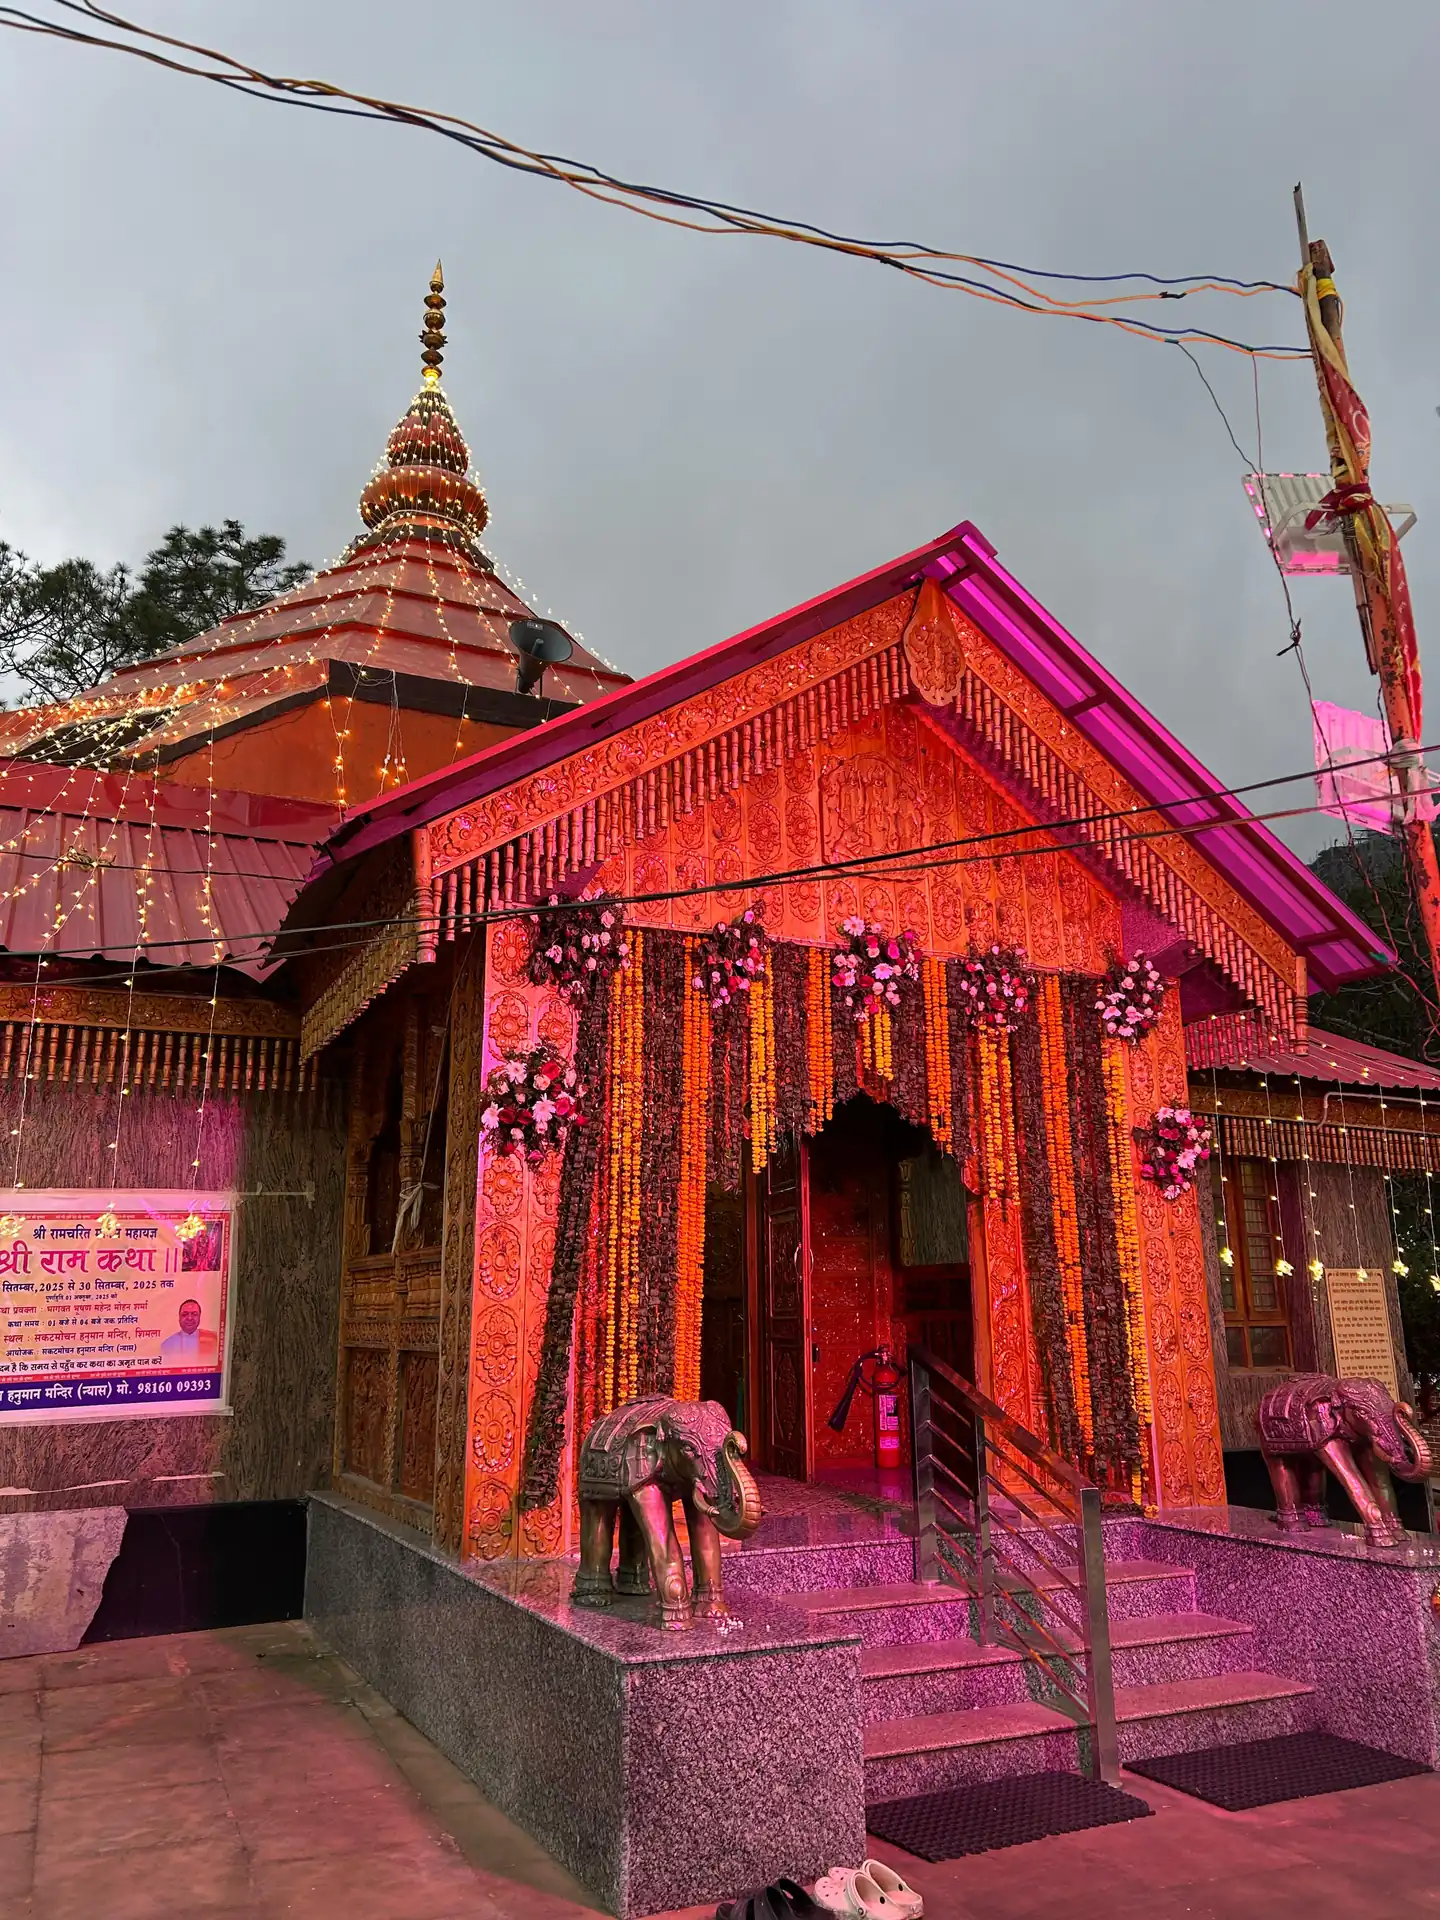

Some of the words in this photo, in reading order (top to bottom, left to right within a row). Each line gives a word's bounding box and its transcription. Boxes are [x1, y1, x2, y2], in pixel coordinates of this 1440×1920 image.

[33, 1225, 46, 1239] श्री
[50, 1224, 91, 1239] रामचरित
[125, 1228, 158, 1240] महायज्ञ
[40, 1250, 90, 1274] राम
[97, 1248, 157, 1272] कथा
[67, 1279, 75, 1291] से
[79, 1282, 91, 1290] 30
[133, 1281, 157, 1289] 2025
[160, 1280, 174, 1288] तक
[114, 1302, 131, 1311] मोहन
[4, 1334, 23, 1343] स्थल
[79, 1332, 104, 1343] हनुमान
[135, 1327, 161, 1338] शिमला
[76, 1346, 96, 1356] हनुमान
[19, 1362, 29, 1371] कि
[31, 1363, 49, 1371] समय
[51, 1360, 58, 1369] से
[118, 1359, 136, 1368] अमृत
[7, 1388, 42, 1405] हनुमान
[45, 1383, 73, 1398] मन्दिर
[77, 1381, 112, 1399] (न्यास)
[116, 1380, 132, 1394] मो.
[137, 1381, 172, 1394] 98160
[176, 1380, 211, 1392] 09393
